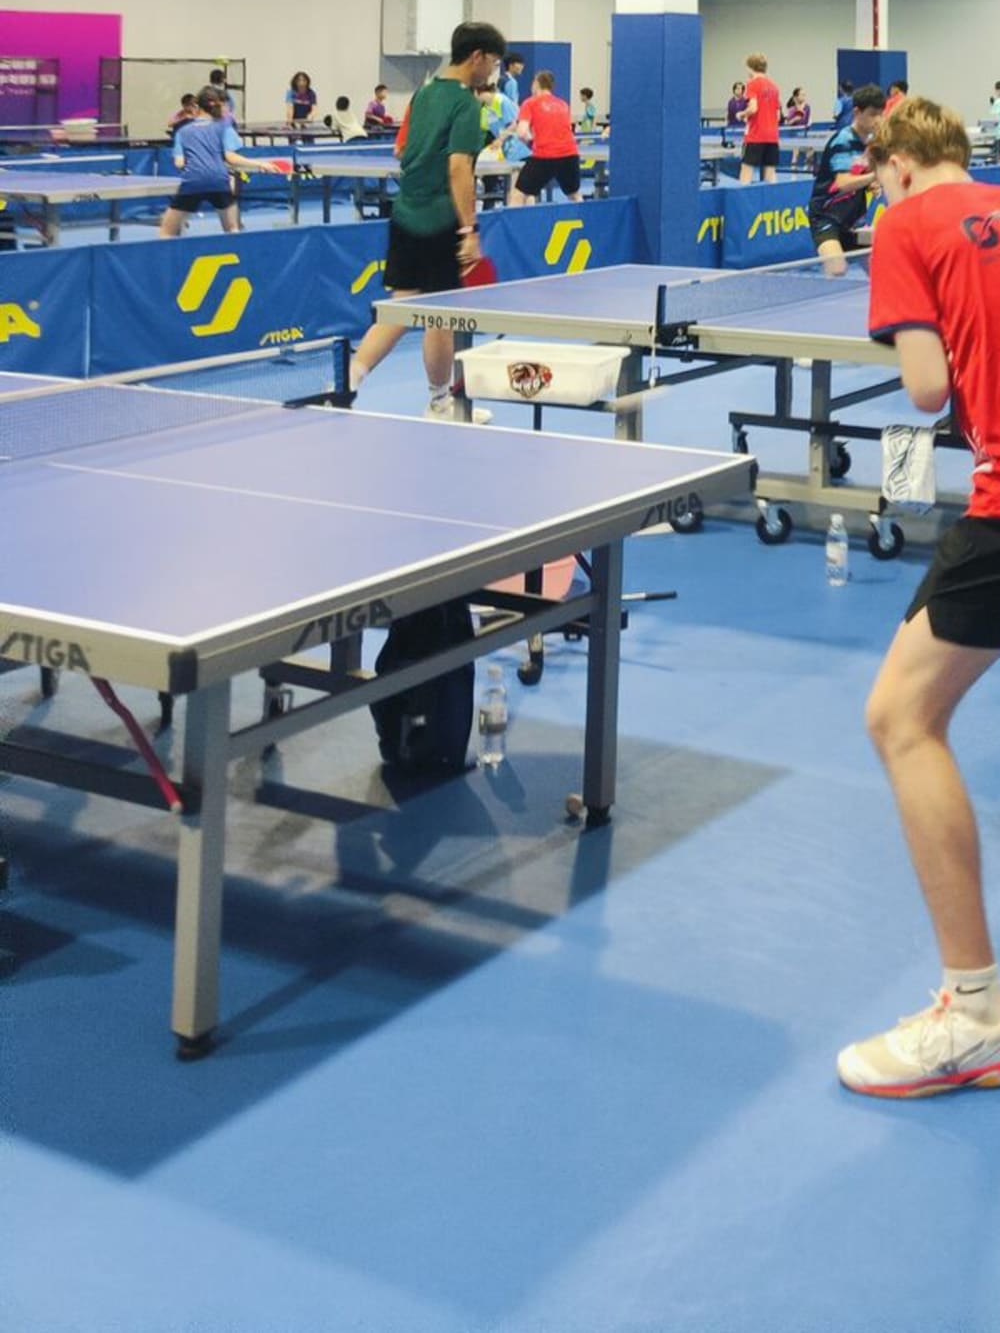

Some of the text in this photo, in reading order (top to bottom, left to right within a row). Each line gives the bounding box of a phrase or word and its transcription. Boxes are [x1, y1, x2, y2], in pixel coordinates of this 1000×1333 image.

[413, 314, 478, 332] 7190-PRO
[640, 492, 703, 531] STIGA
[291, 597, 393, 654] STIGA
[0, 632, 91, 674] STIGA
